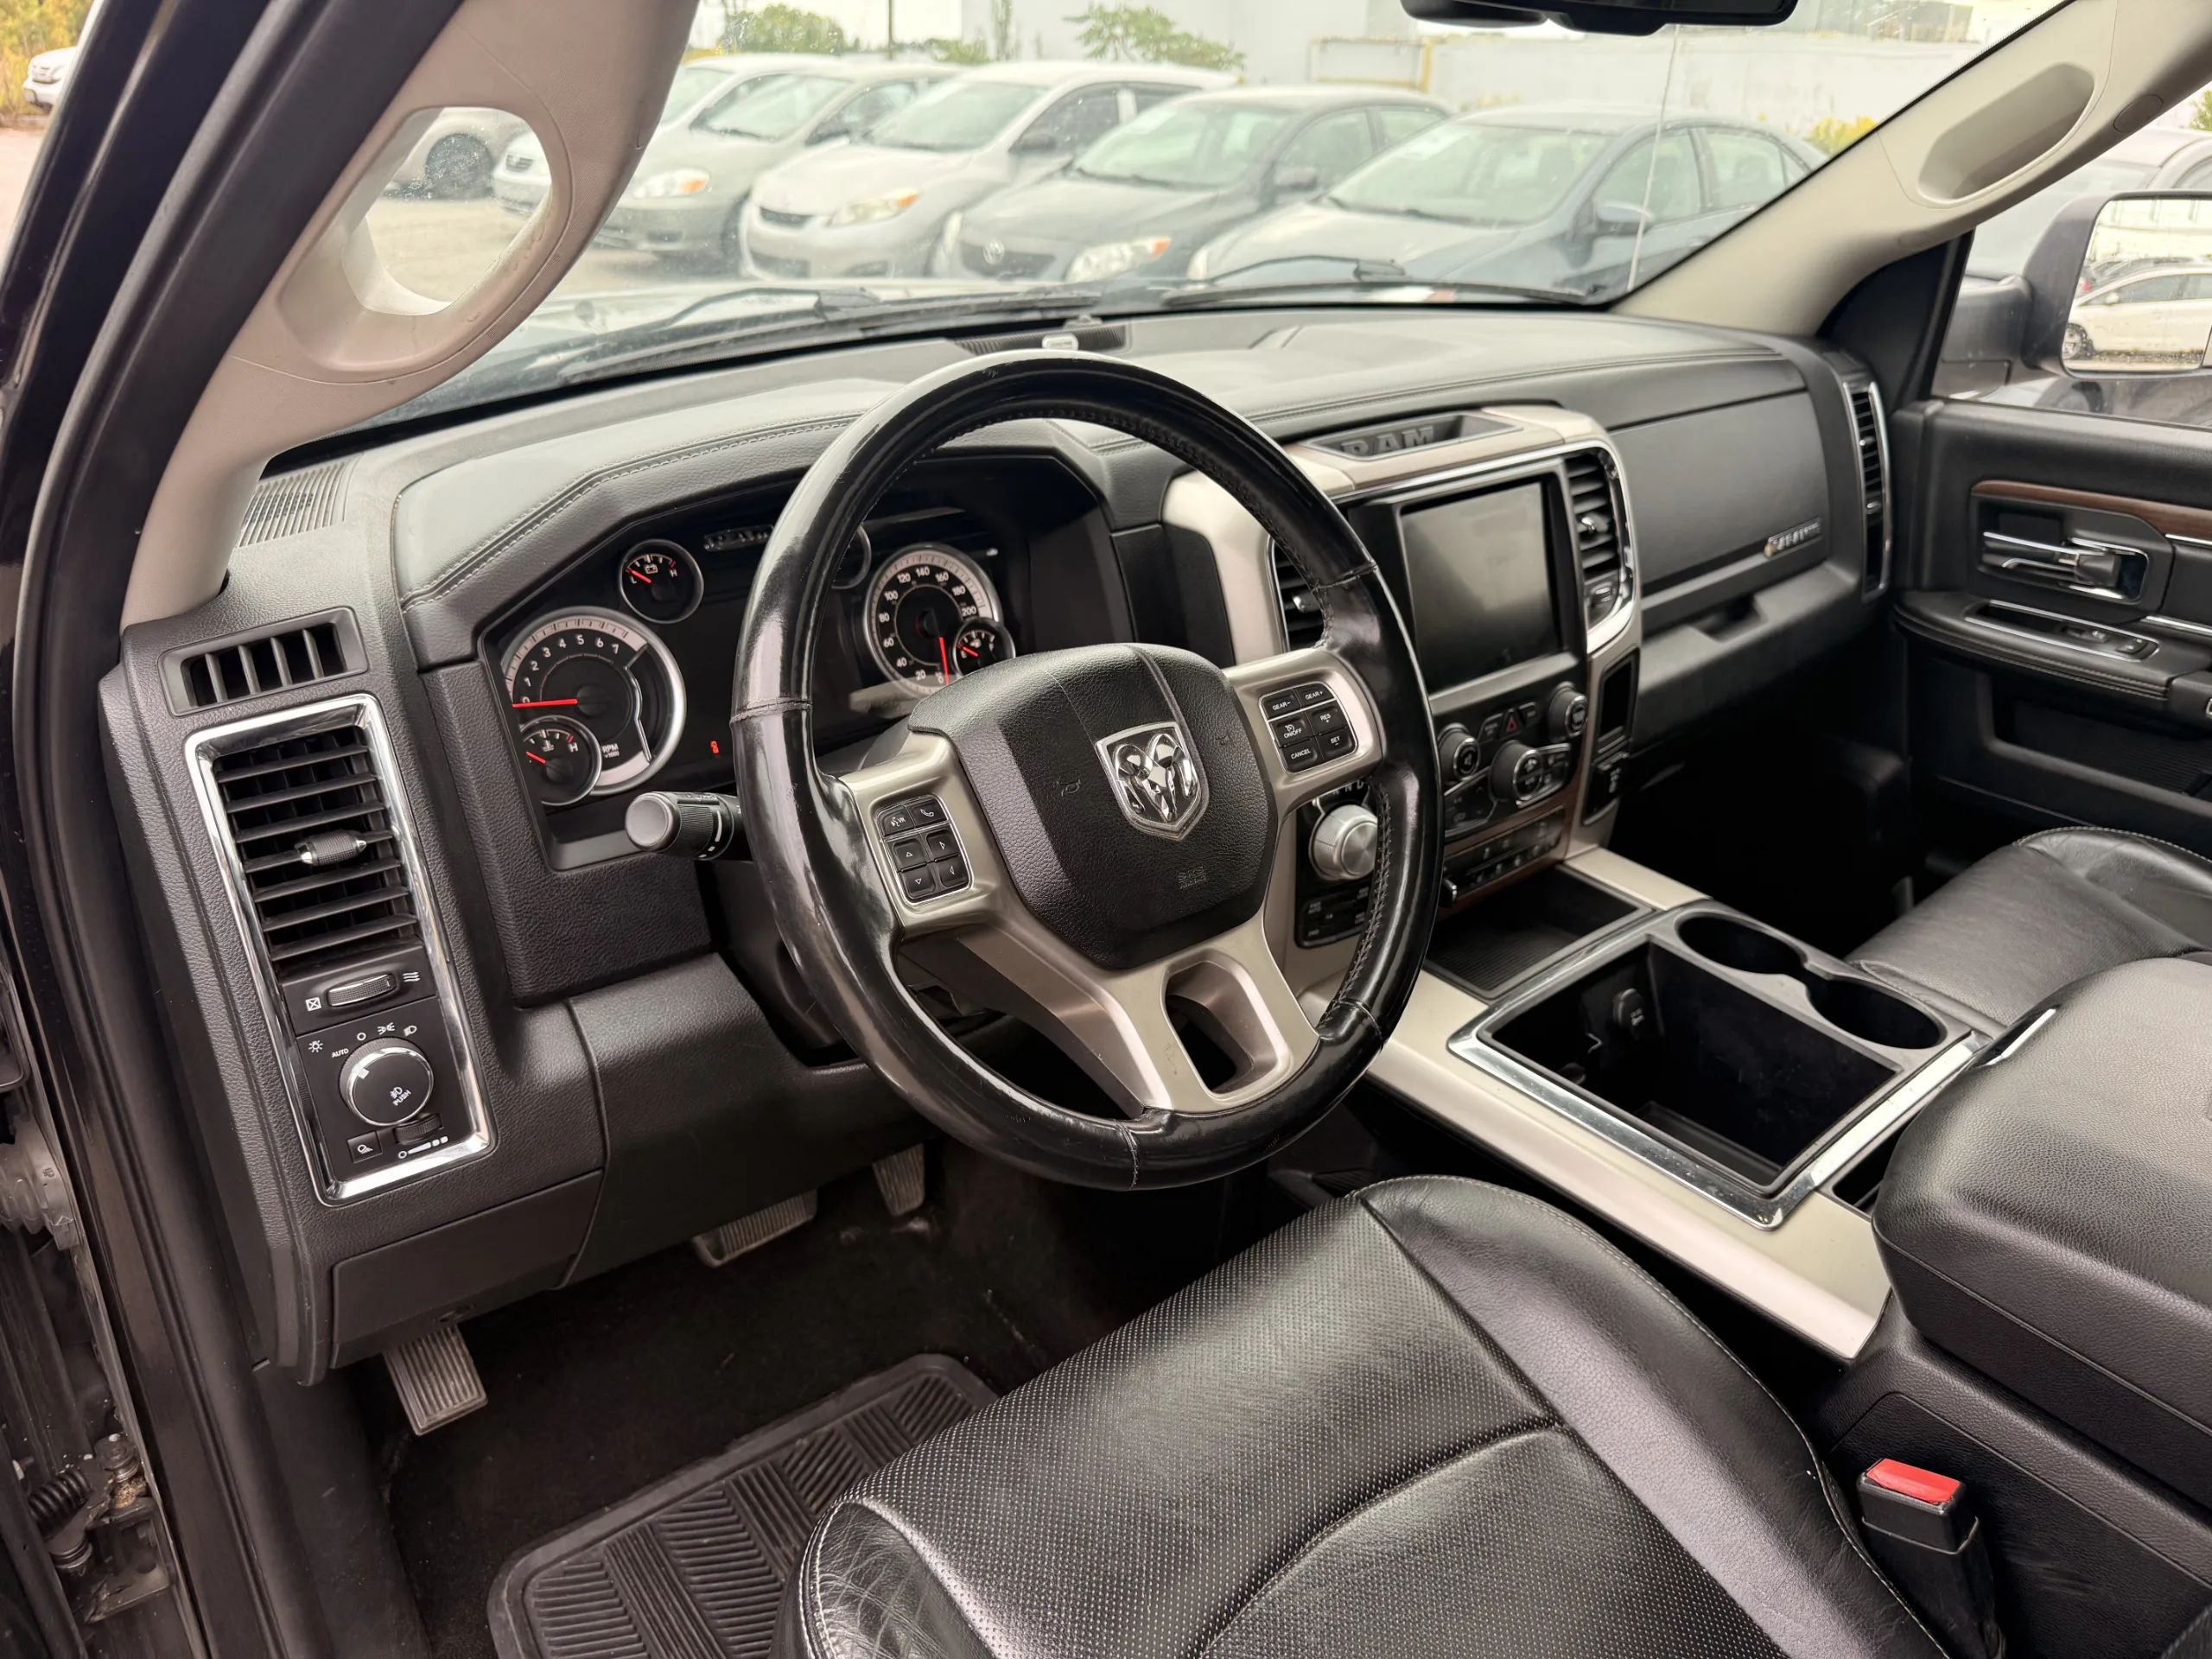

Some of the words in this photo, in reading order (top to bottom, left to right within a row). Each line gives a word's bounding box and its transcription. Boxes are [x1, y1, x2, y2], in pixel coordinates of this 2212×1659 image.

[916, 566, 930, 577] 140
[935, 571, 949, 582] 160
[898, 572, 911, 583] 120
[884, 590, 899, 601] 100
[952, 585, 966, 596] 180
[962, 606, 977, 617] 200
[879, 612, 890, 623] 80
[557, 638, 566, 648] 4
[575, 634, 585, 645] 5
[595, 638, 604, 647] 6
[883, 637, 894, 648] 60
[542, 647, 551, 658] 3
[612, 644, 620, 654] 7
[531, 660, 539, 671] 2
[896, 657, 907, 667] 40
[916, 670, 926, 681] 20
[523, 677, 532, 687] 1
[569, 742, 579, 753] H
[602, 743, 619, 753] RPM
[1291, 748, 1312, 760] CANCEL
[331, 1048, 349, 1058] AUTO
[392, 1090, 411, 1106] PUSH
